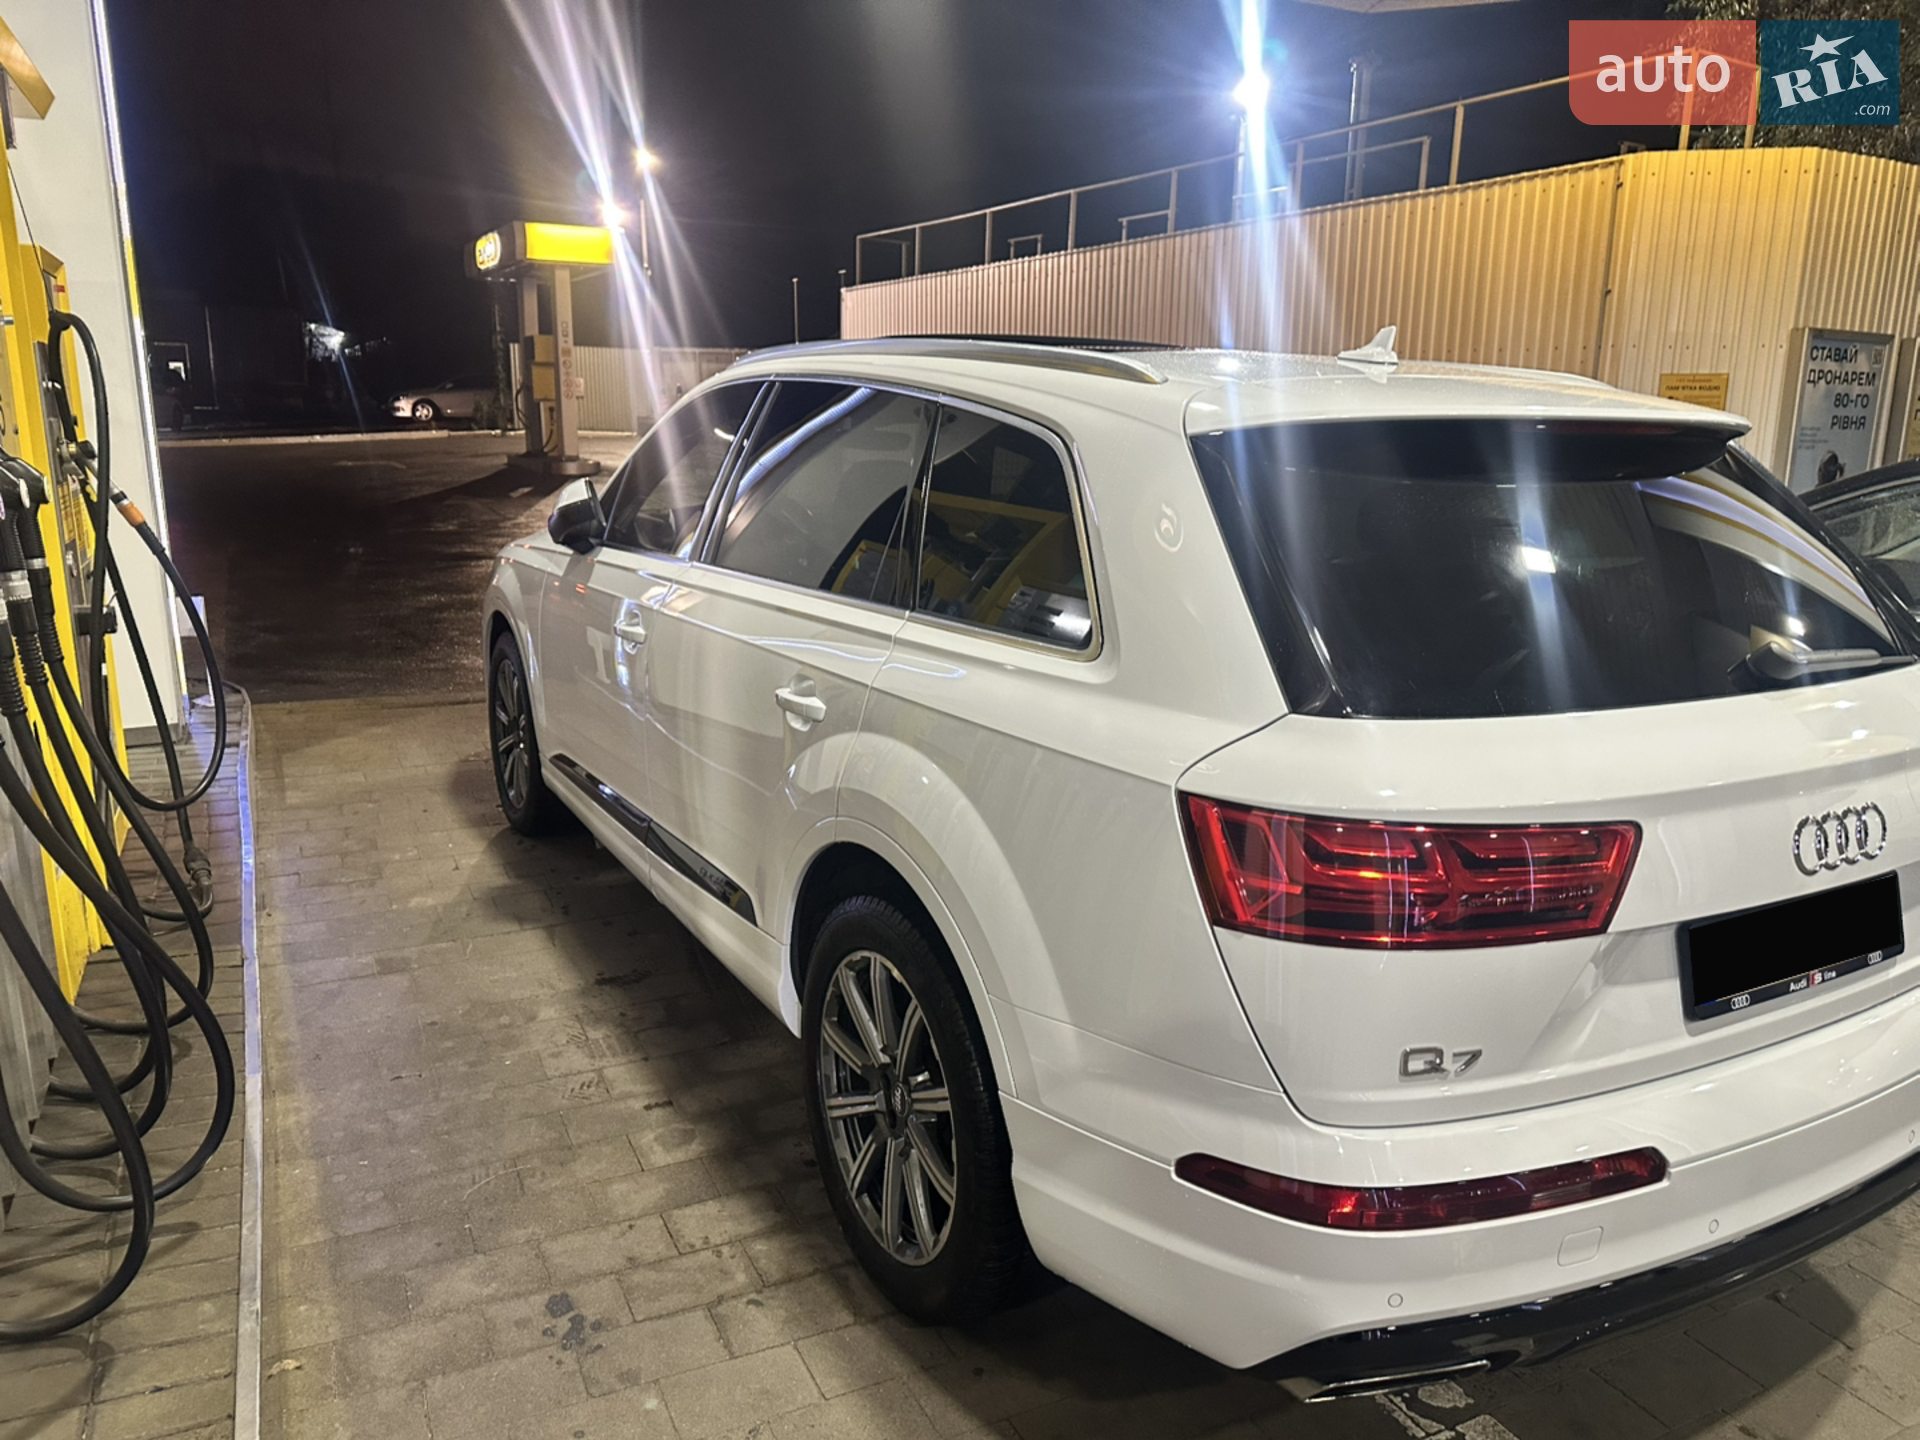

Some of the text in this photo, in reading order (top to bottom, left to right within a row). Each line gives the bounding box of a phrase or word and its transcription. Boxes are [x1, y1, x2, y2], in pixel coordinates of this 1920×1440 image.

[1809, 345, 1859, 364] СТАВАЙ
[1807, 368, 1877, 387] ДРОНАРЕМ
[1833, 393, 1870, 409] 80-ГО
[1830, 414, 1867, 430] РІВНЯ
[1789, 977, 1808, 992] Audi
[1399, 1046, 1483, 1081] Q7
